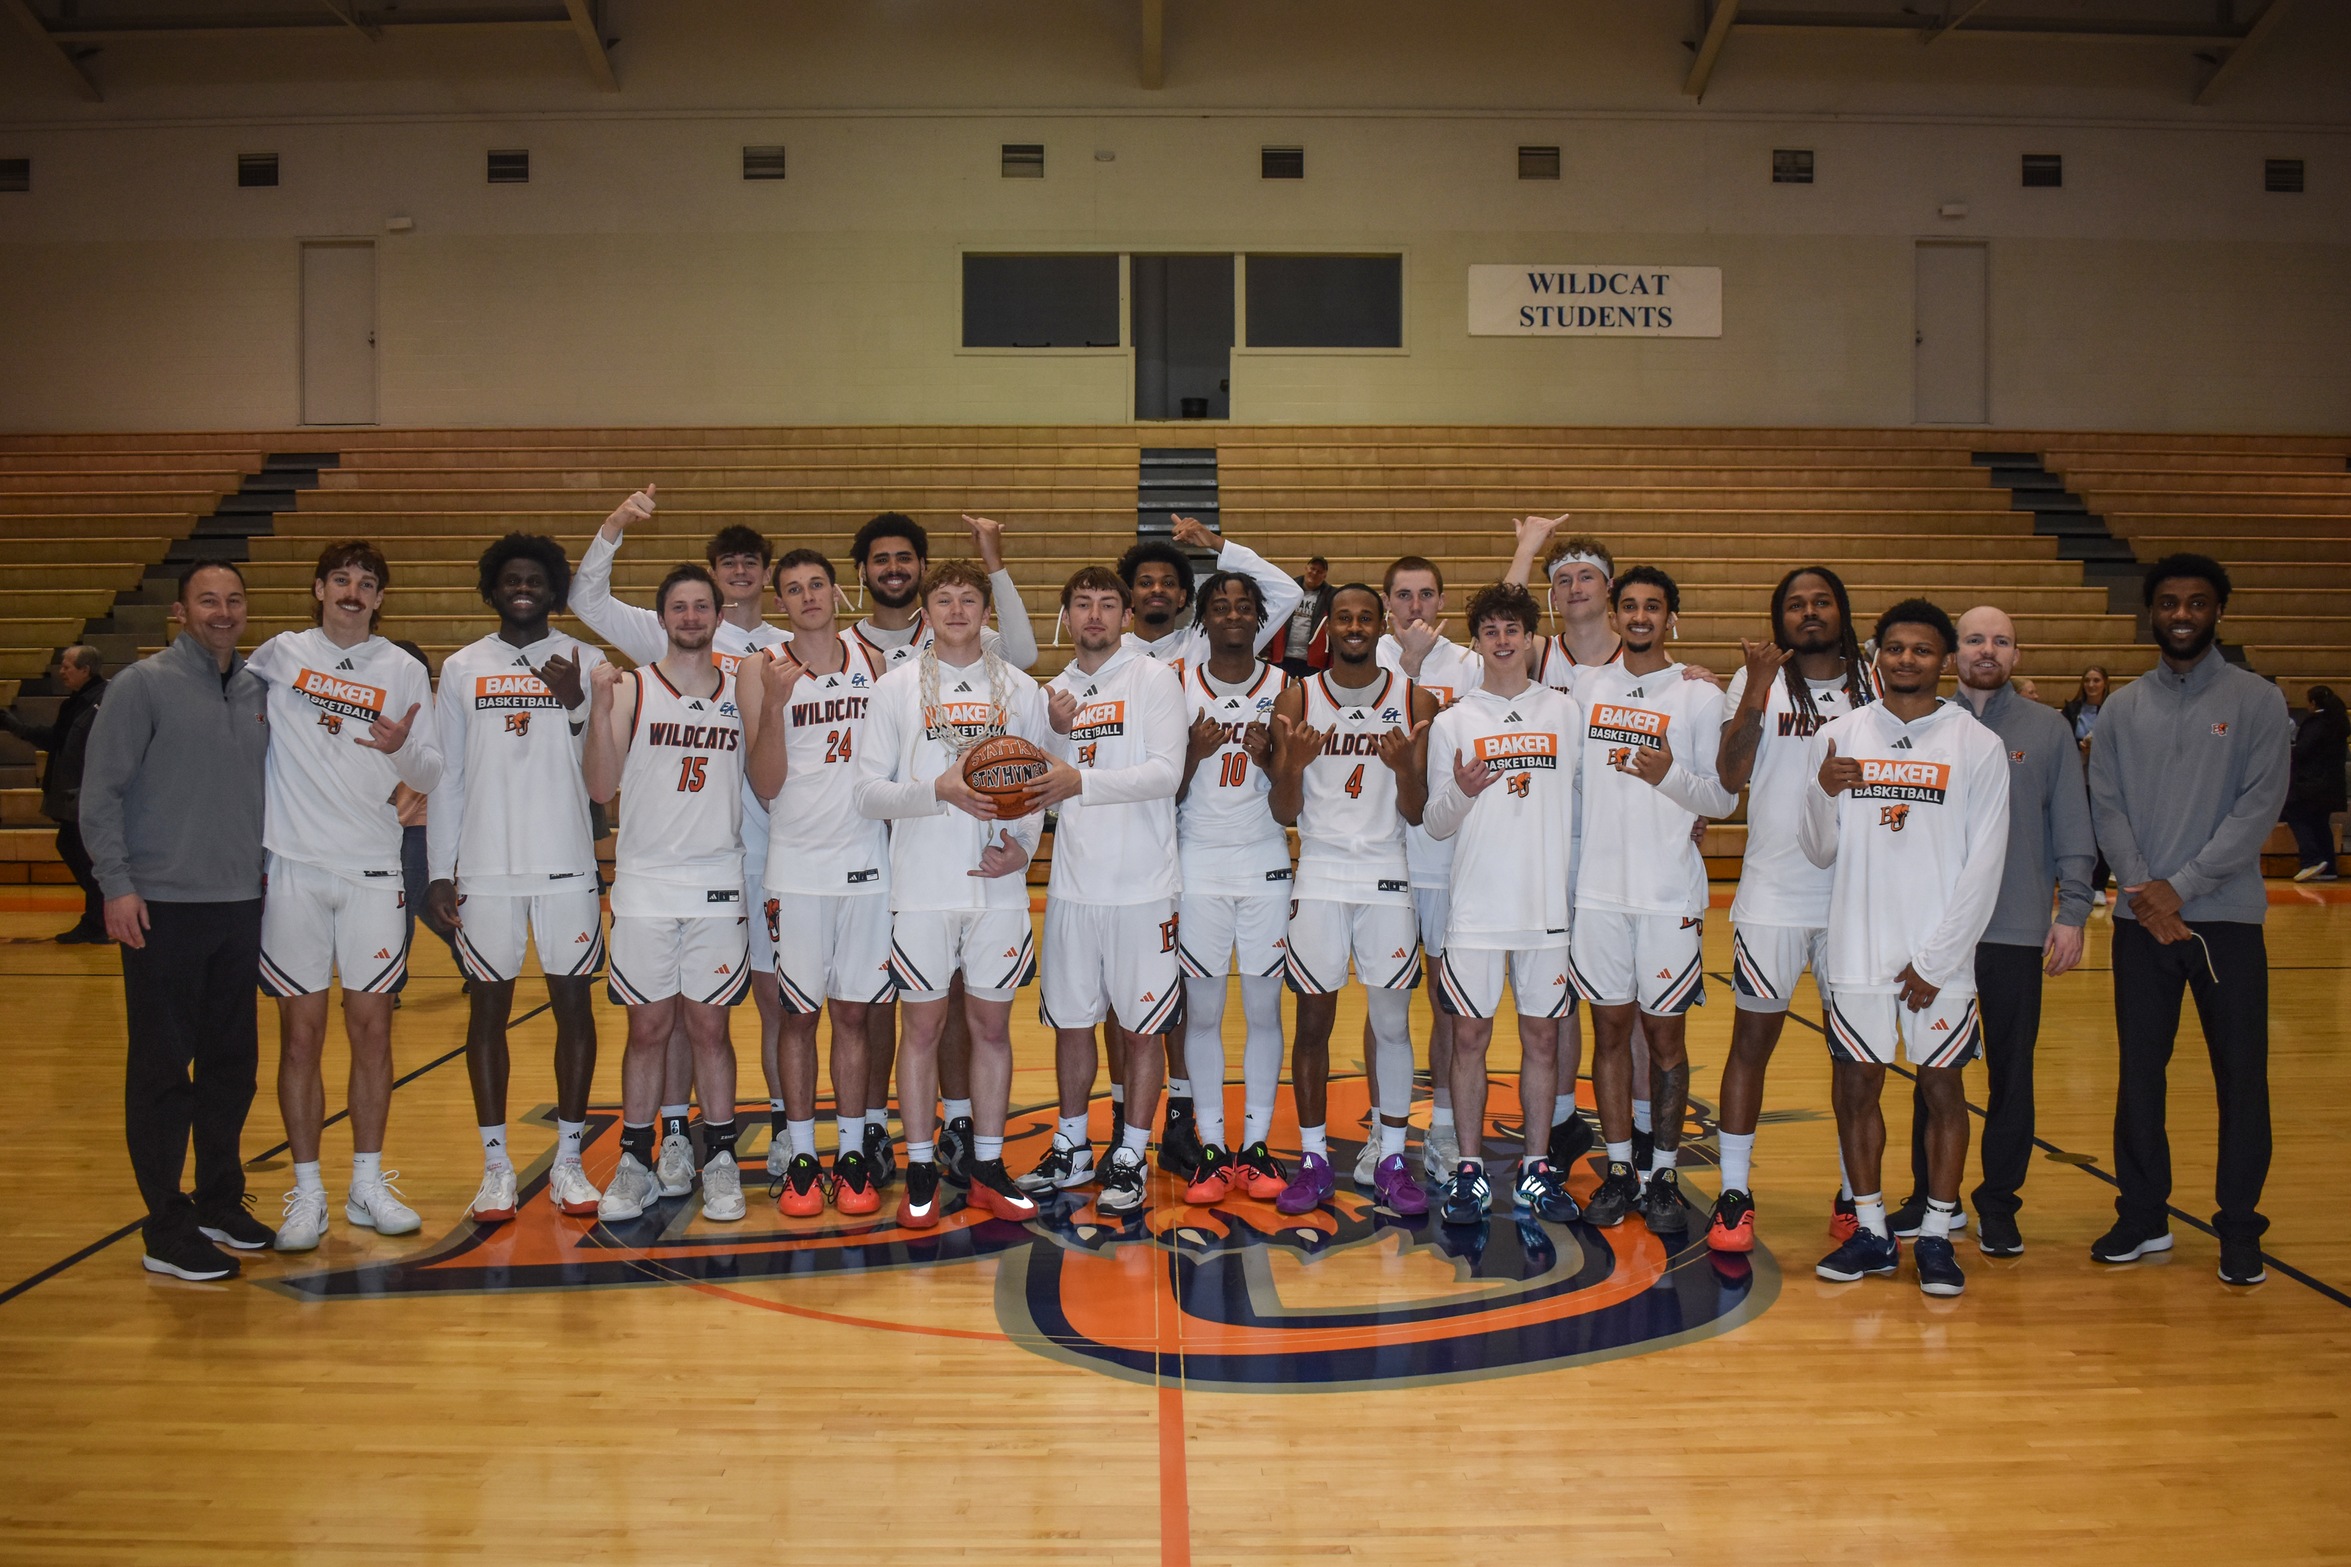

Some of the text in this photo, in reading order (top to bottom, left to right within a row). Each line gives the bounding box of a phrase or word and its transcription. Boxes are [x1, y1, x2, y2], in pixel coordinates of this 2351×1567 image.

[1527, 272, 1670, 296] WILDCAT
[1519, 305, 1673, 328] STUDENTS
[305, 673, 376, 707] BAKER
[478, 696, 560, 708] BASKETBALL
[1071, 724, 1121, 740] SKETBALL
[1598, 706, 1660, 733] BAKER
[650, 722, 739, 752] WILDCATS
[824, 727, 852, 763] 24
[1484, 735, 1550, 757] BAKER
[1590, 727, 1660, 749] BASKETBALL
[972, 740, 1003, 766] STAY
[677, 756, 709, 792] 15
[972, 765, 1001, 788] STAY
[1219, 752, 1249, 787] 10
[1345, 763, 1364, 799] 4
[1863, 761, 1939, 785] BAKER
